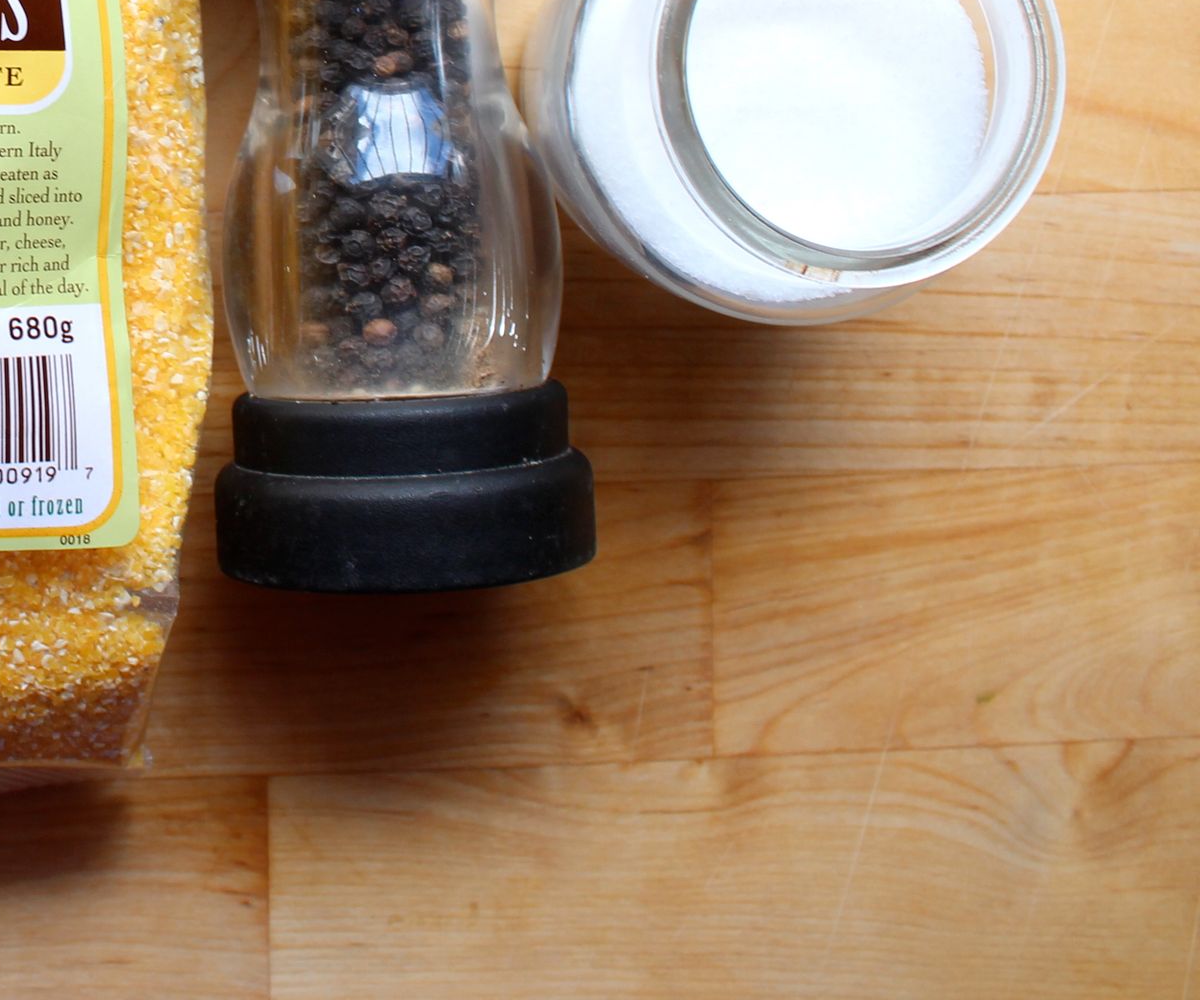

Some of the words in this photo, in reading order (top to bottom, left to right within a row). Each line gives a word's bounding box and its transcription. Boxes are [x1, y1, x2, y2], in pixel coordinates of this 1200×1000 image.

[29, 140, 62, 162] Italy
[0, 169, 39, 181] eaten
[9, 186, 50, 204] sliced
[54, 191, 83, 203] into
[26, 210, 74, 230] honey.
[15, 233, 66, 250] cheese,
[11, 255, 39, 273] rich
[43, 254, 70, 272] and
[30, 278, 53, 295] the
[57, 276, 89, 298] day.
[9, 315, 74, 344] 680g
[8, 500, 25, 517] or
[32, 495, 83, 516] frozen
[60, 533, 90, 545] 0018
